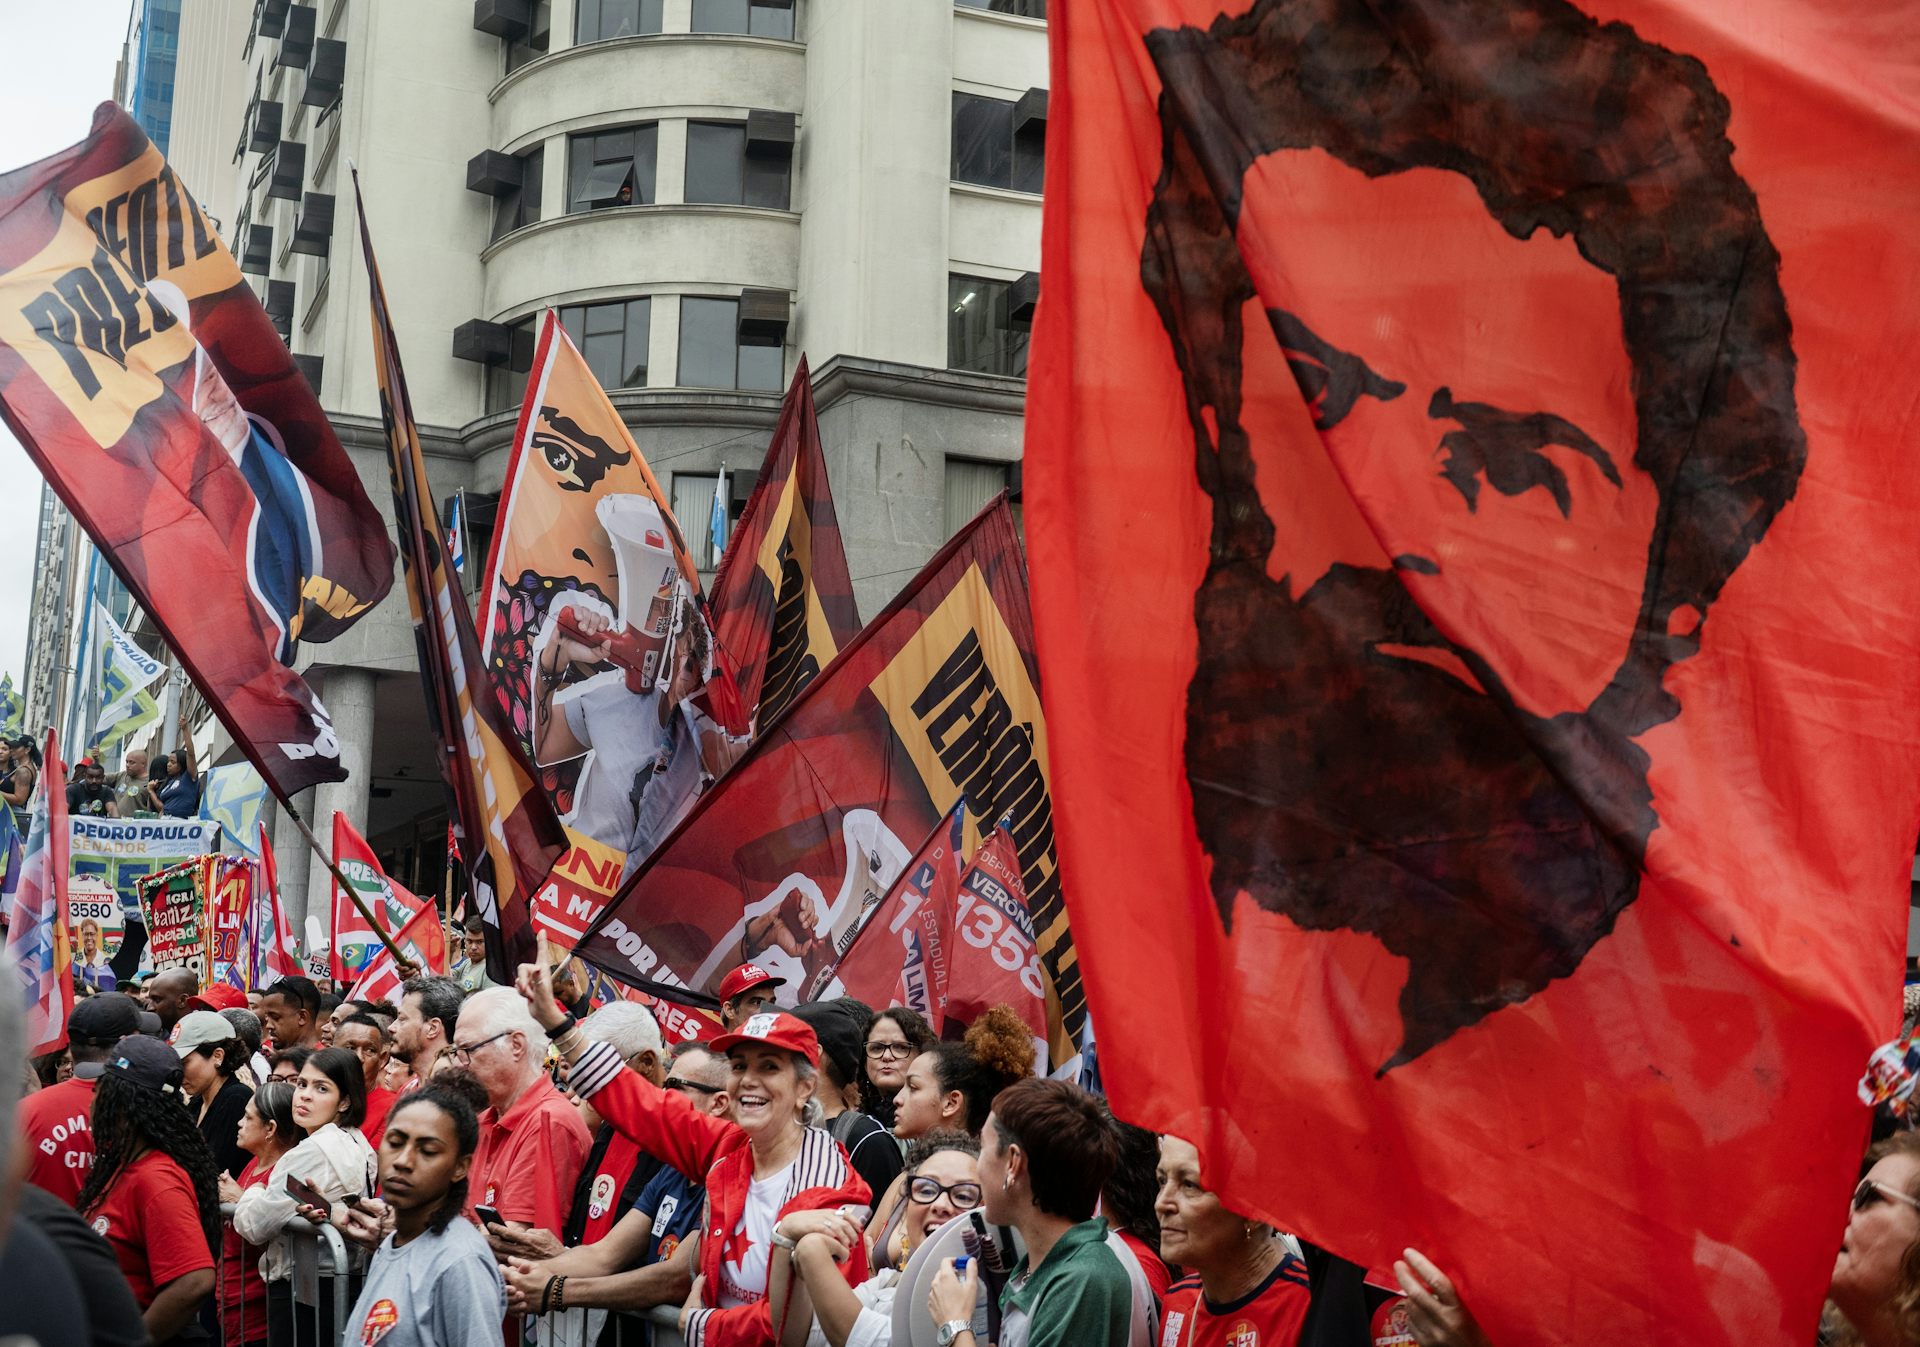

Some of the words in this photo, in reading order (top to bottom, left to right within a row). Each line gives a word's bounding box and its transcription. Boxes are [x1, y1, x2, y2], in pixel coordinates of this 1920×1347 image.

[72, 838, 147, 854] SENADOR
[73, 821, 138, 841] PEDRO
[140, 825, 203, 841] PAULO
[971, 871, 1037, 941] VERÔNI
[598, 918, 658, 975] POR
[923, 909, 946, 991] ESTADUAL
